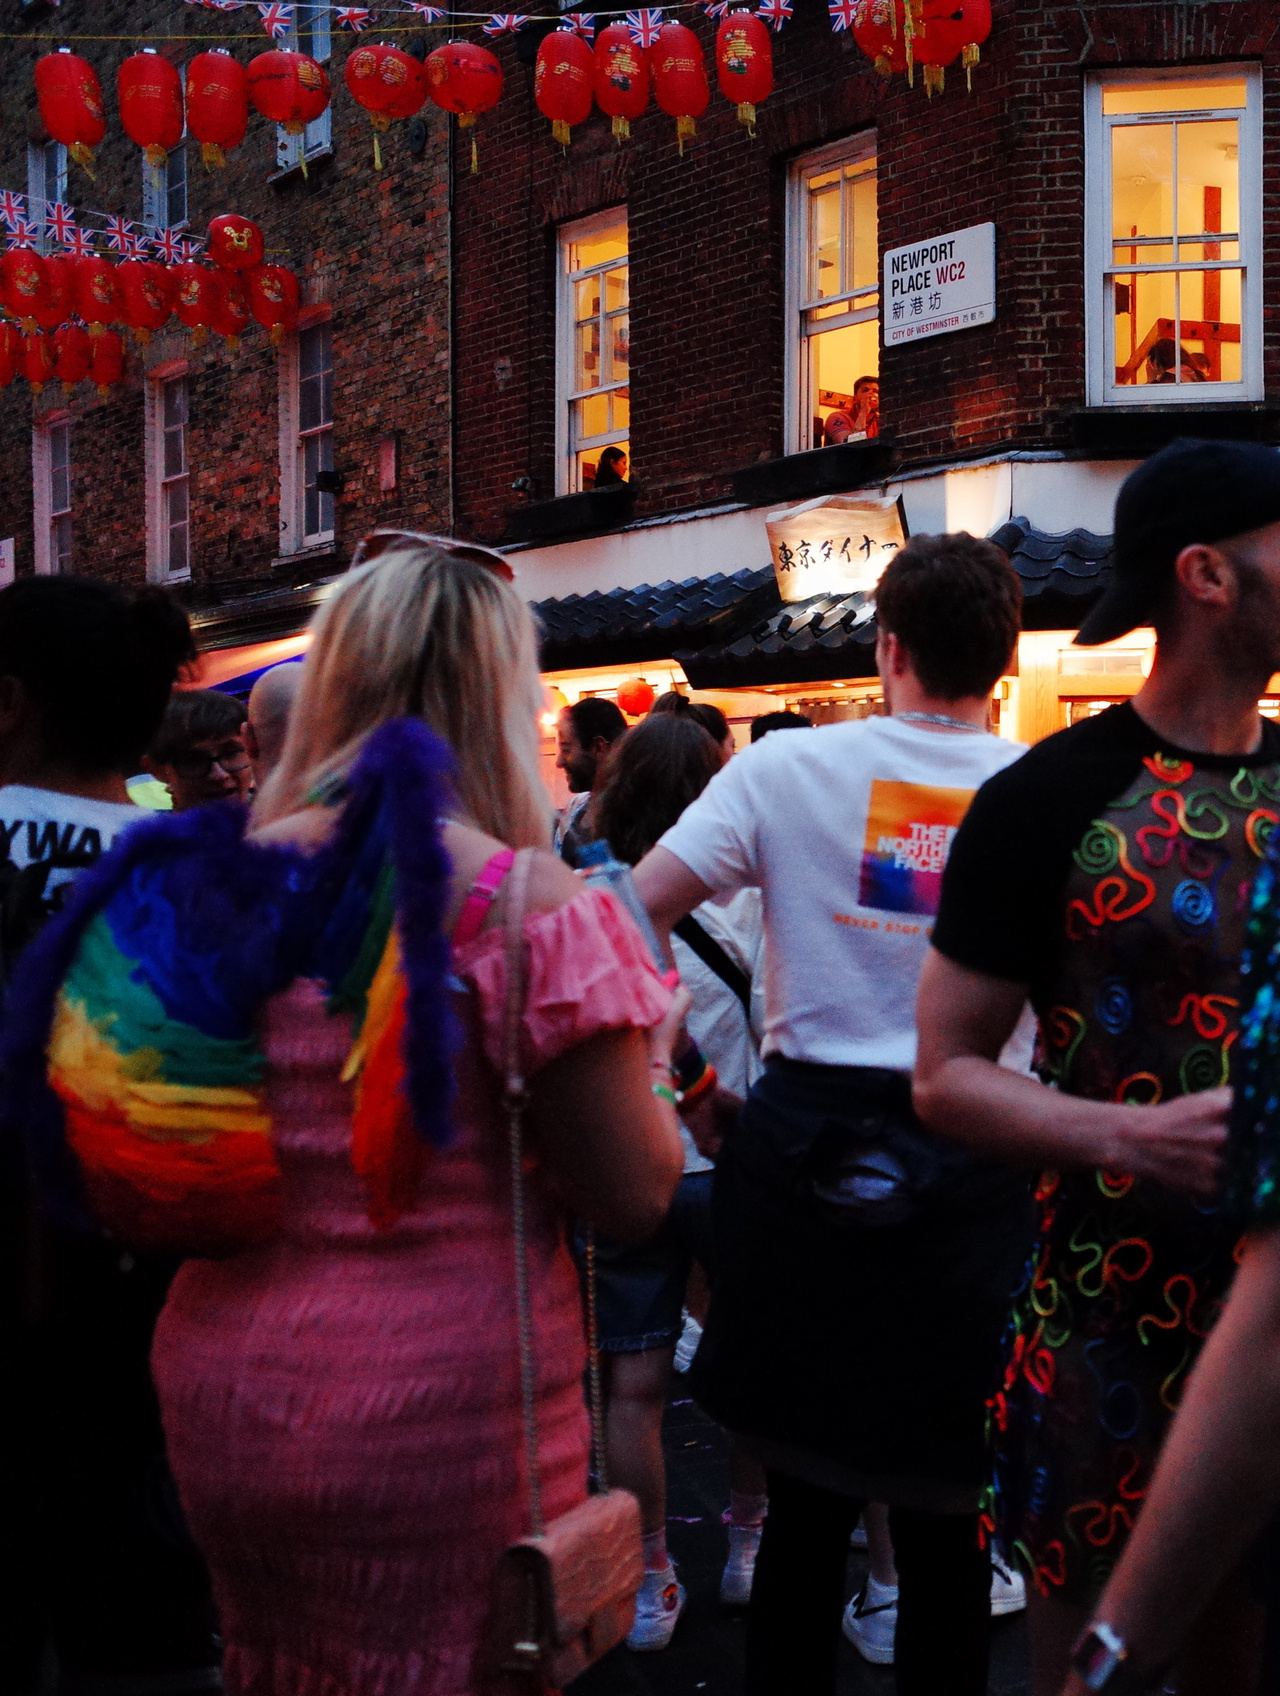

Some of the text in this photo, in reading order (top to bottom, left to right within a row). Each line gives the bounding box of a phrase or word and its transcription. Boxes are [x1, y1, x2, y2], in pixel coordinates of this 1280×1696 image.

[892, 240, 956, 275] NEWPORT
[892, 261, 966, 298] PLACE WC2
[892, 291, 942, 321] 新港坊
[892, 316, 959, 340] CITY OF WESTMINSTER
